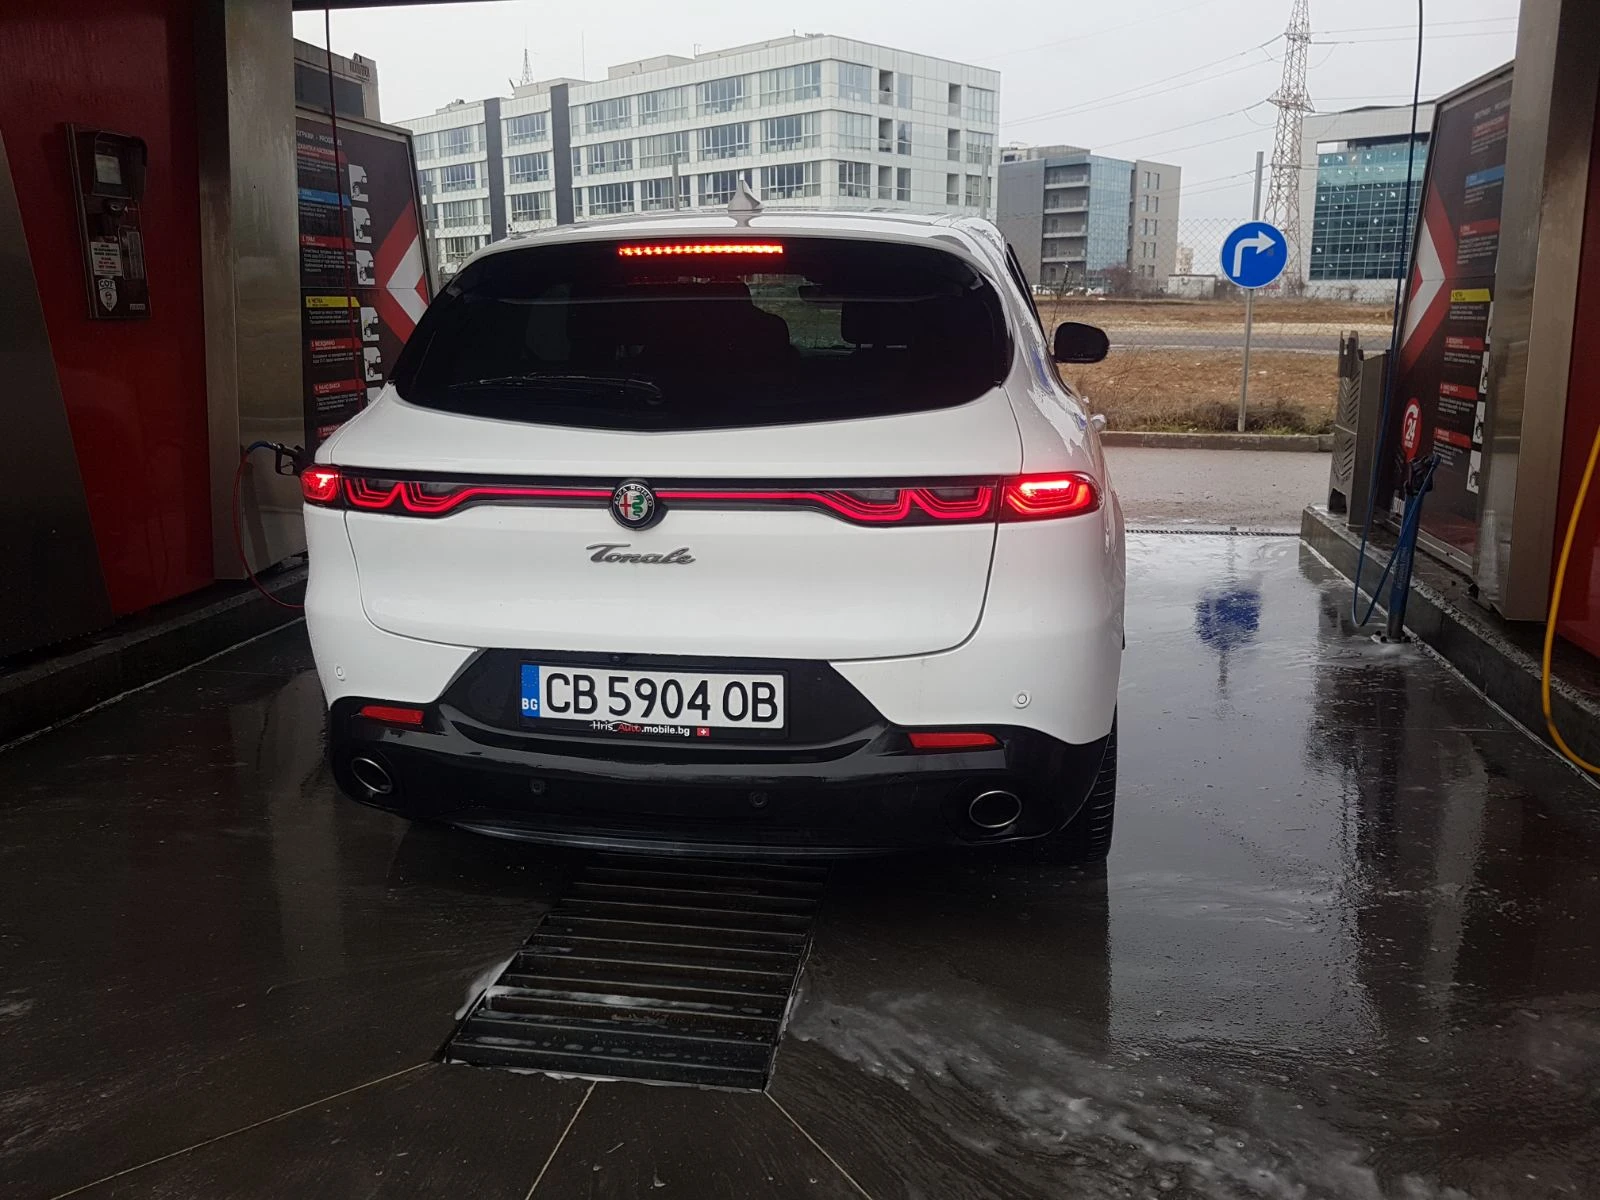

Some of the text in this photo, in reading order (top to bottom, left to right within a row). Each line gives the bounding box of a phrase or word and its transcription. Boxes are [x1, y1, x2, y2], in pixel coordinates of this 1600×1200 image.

[1405, 418, 1417, 441] 24
[614, 485, 653, 507] ALFA ROMEO
[585, 543, 697, 565] Tonale
[521, 698, 539, 711] BG
[546, 672, 778, 723] CB 5904 OB
